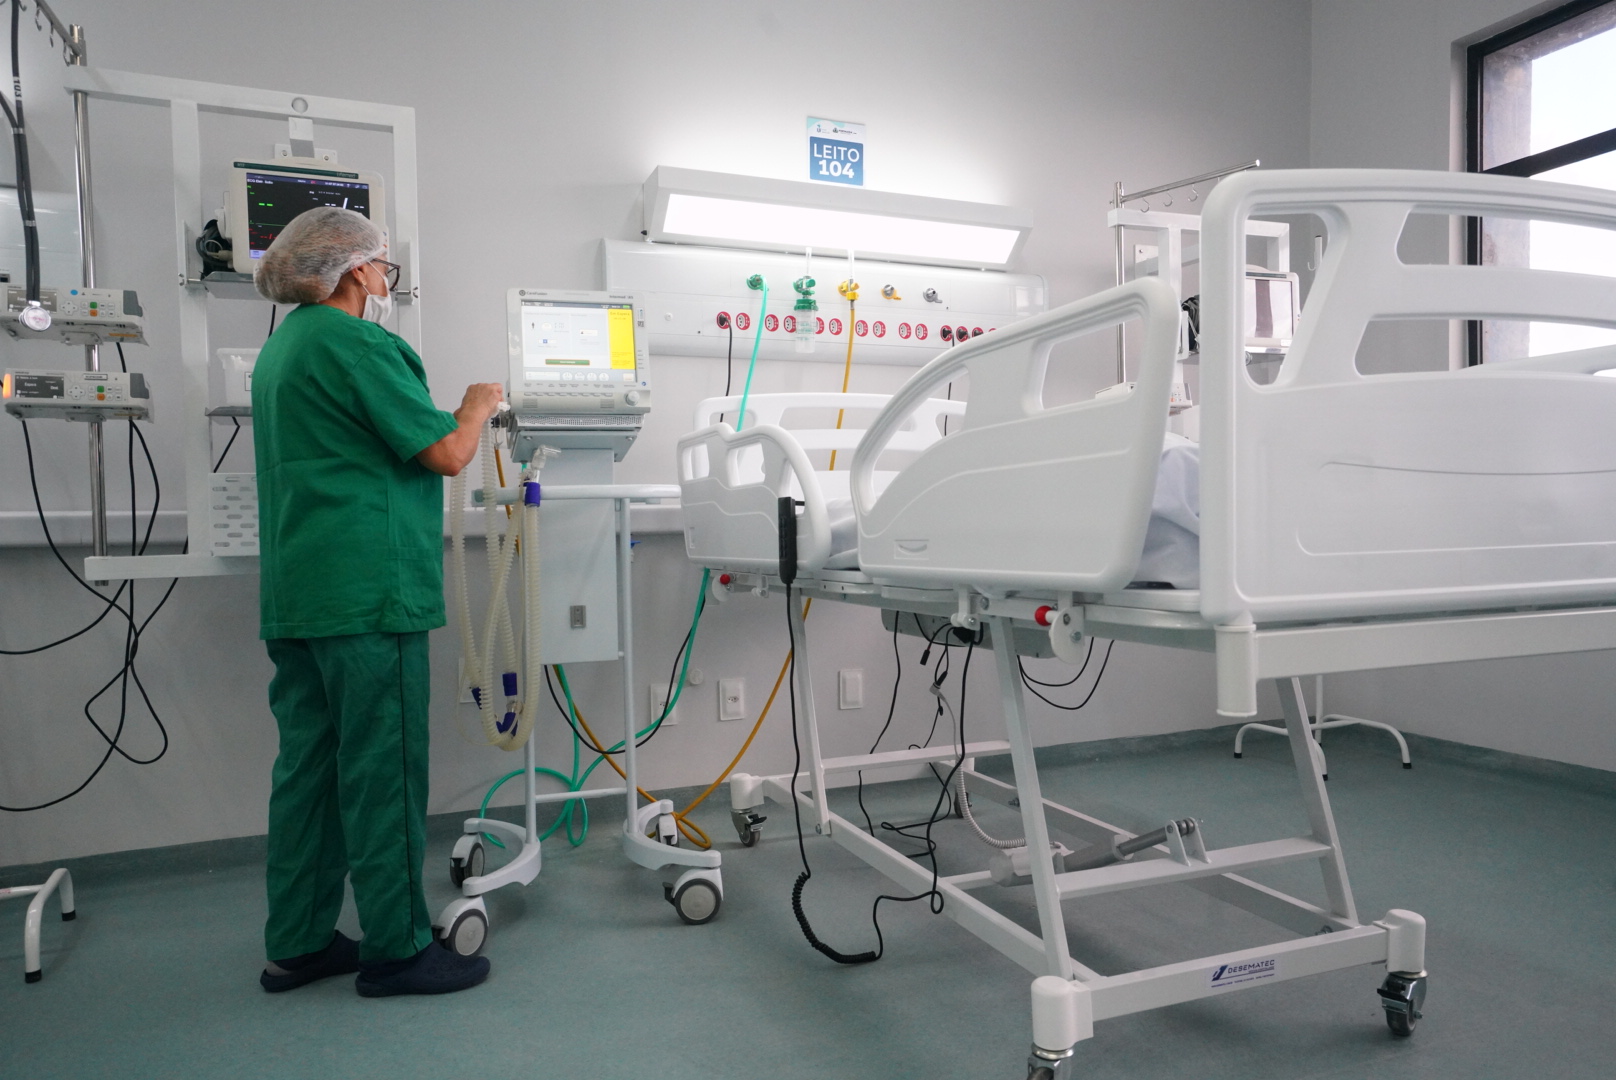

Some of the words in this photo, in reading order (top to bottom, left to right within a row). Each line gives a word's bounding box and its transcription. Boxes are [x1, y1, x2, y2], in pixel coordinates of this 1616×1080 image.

[813, 143, 860, 163] LEITO
[818, 159, 855, 179] 104
[1227, 959, 1275, 974] DESEMATEC
